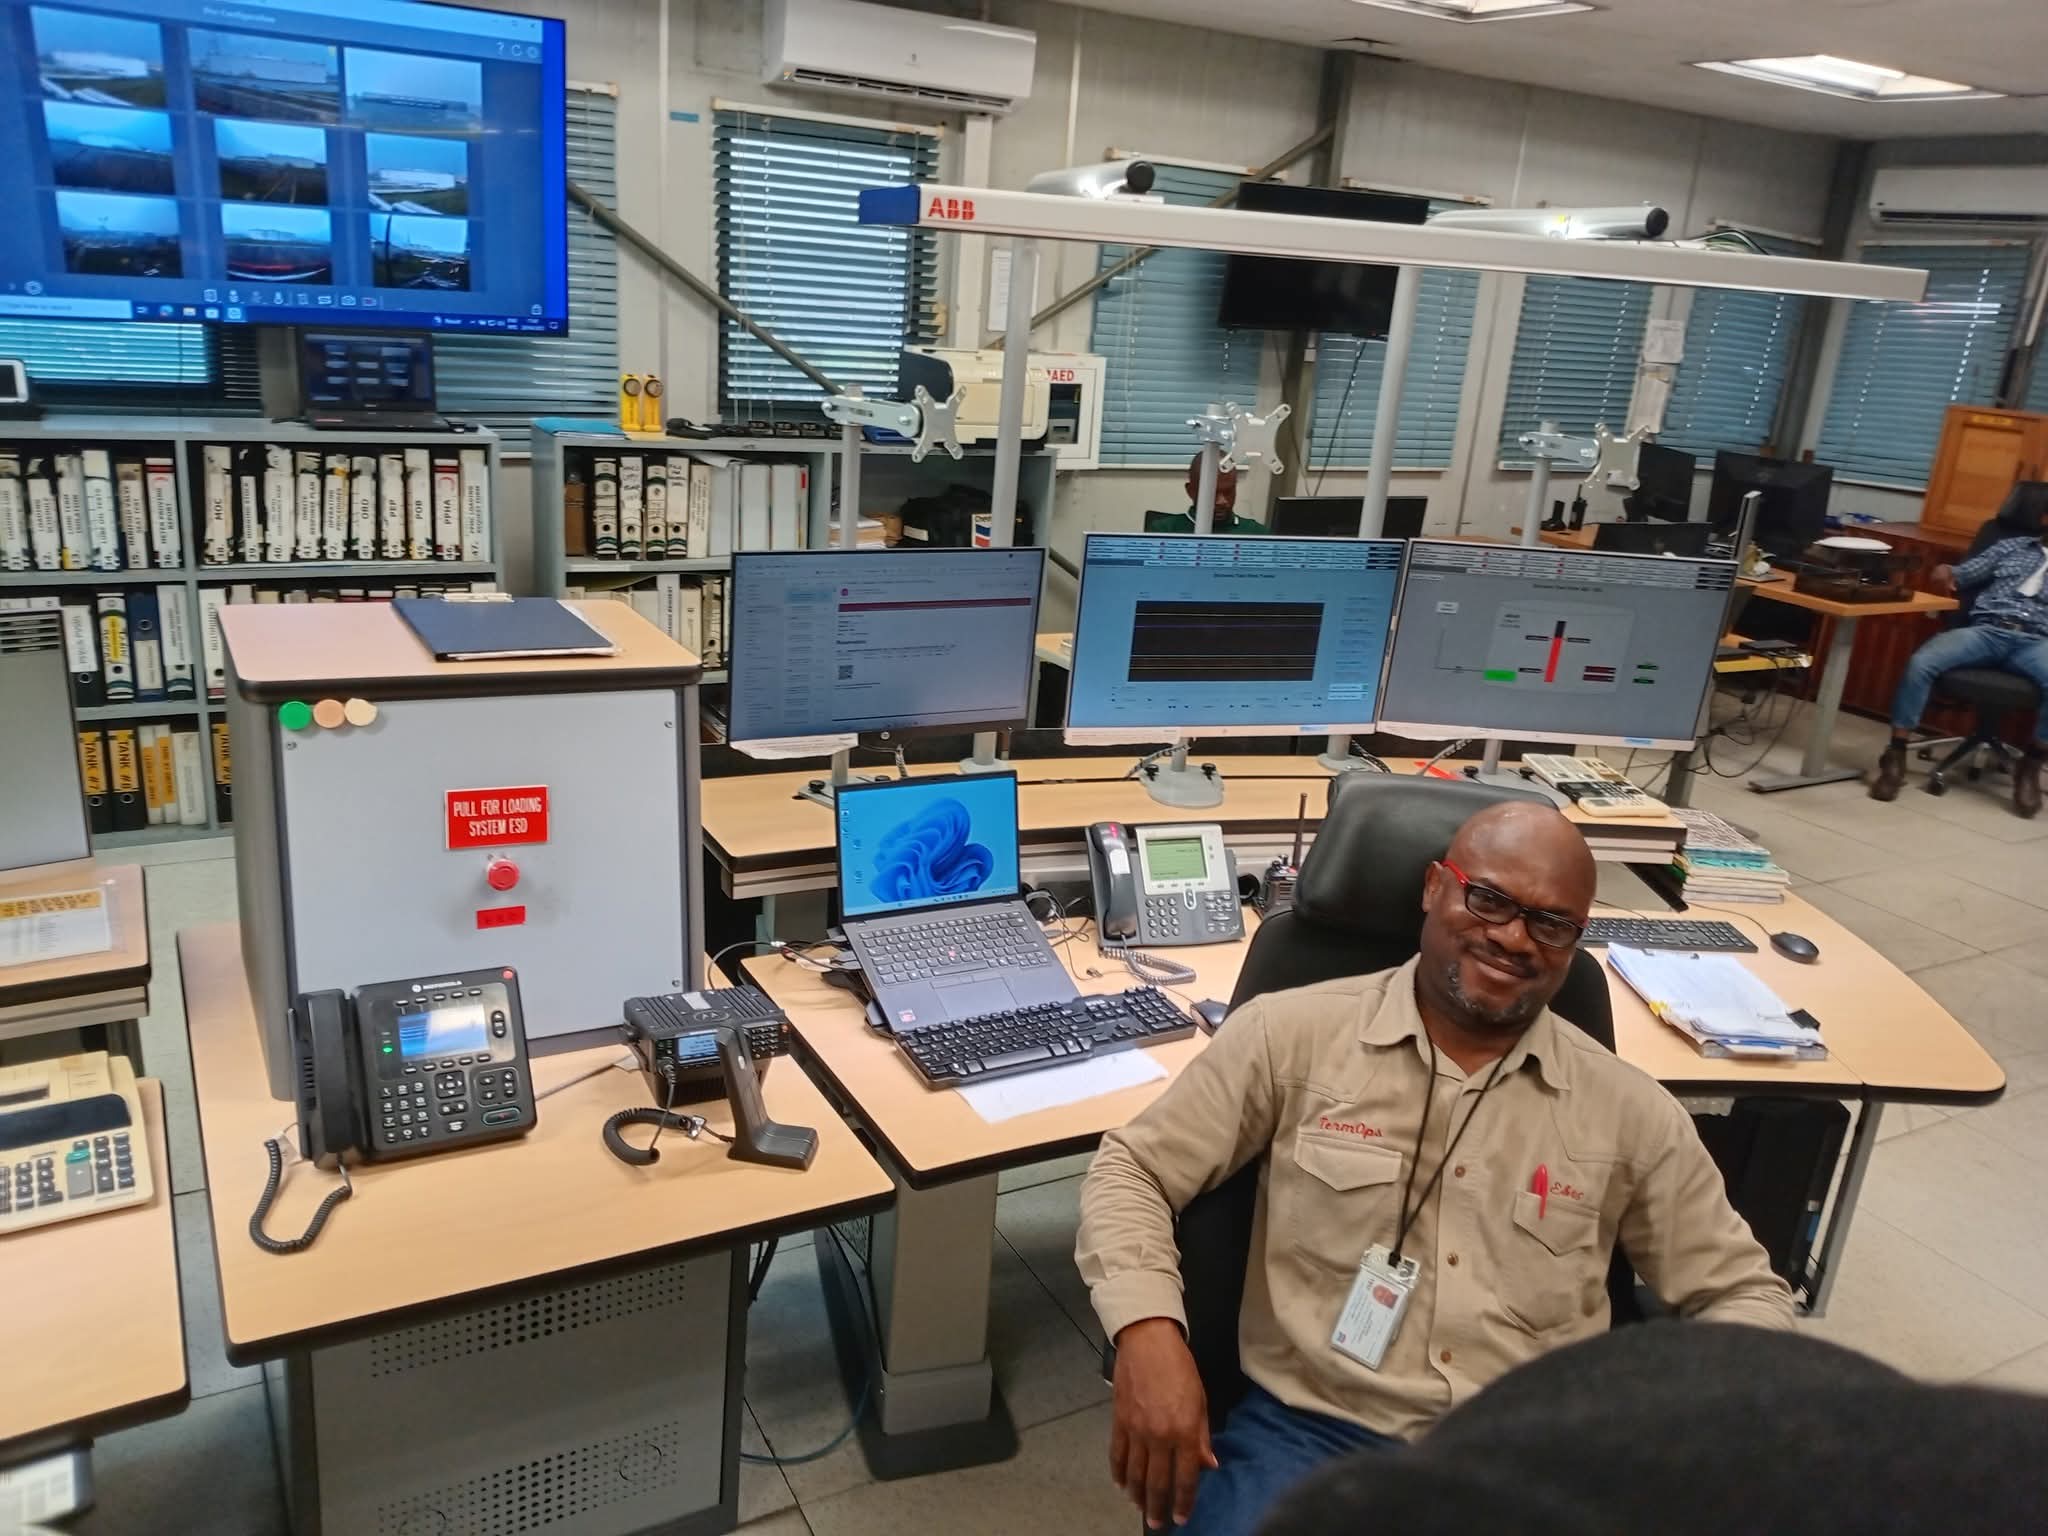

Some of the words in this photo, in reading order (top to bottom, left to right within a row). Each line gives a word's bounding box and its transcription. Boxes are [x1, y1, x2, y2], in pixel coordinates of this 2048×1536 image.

[928, 197, 975, 221] ABB
[1051, 369, 1074, 382] AED
[214, 499, 223, 521] MOC
[328, 489, 336, 529] OPERATING
[389, 499, 397, 518] PEP
[415, 500, 423, 520] POB
[443, 499, 452, 526] PPHA
[273, 544, 283, 559] 40.
[303, 541, 312, 557] 41.
[329, 541, 338, 558] 42.
[84, 742, 98, 770] TANK
[118, 741, 131, 769] TANK
[219, 734, 231, 759] TANK
[88, 776, 101, 791] #7
[453, 801, 479, 818] PULL
[480, 799, 501, 816] FOR
[503, 796, 542, 815] LOADING
[469, 819, 507, 837] SYSTEM
[508, 817, 528, 834] ESD
